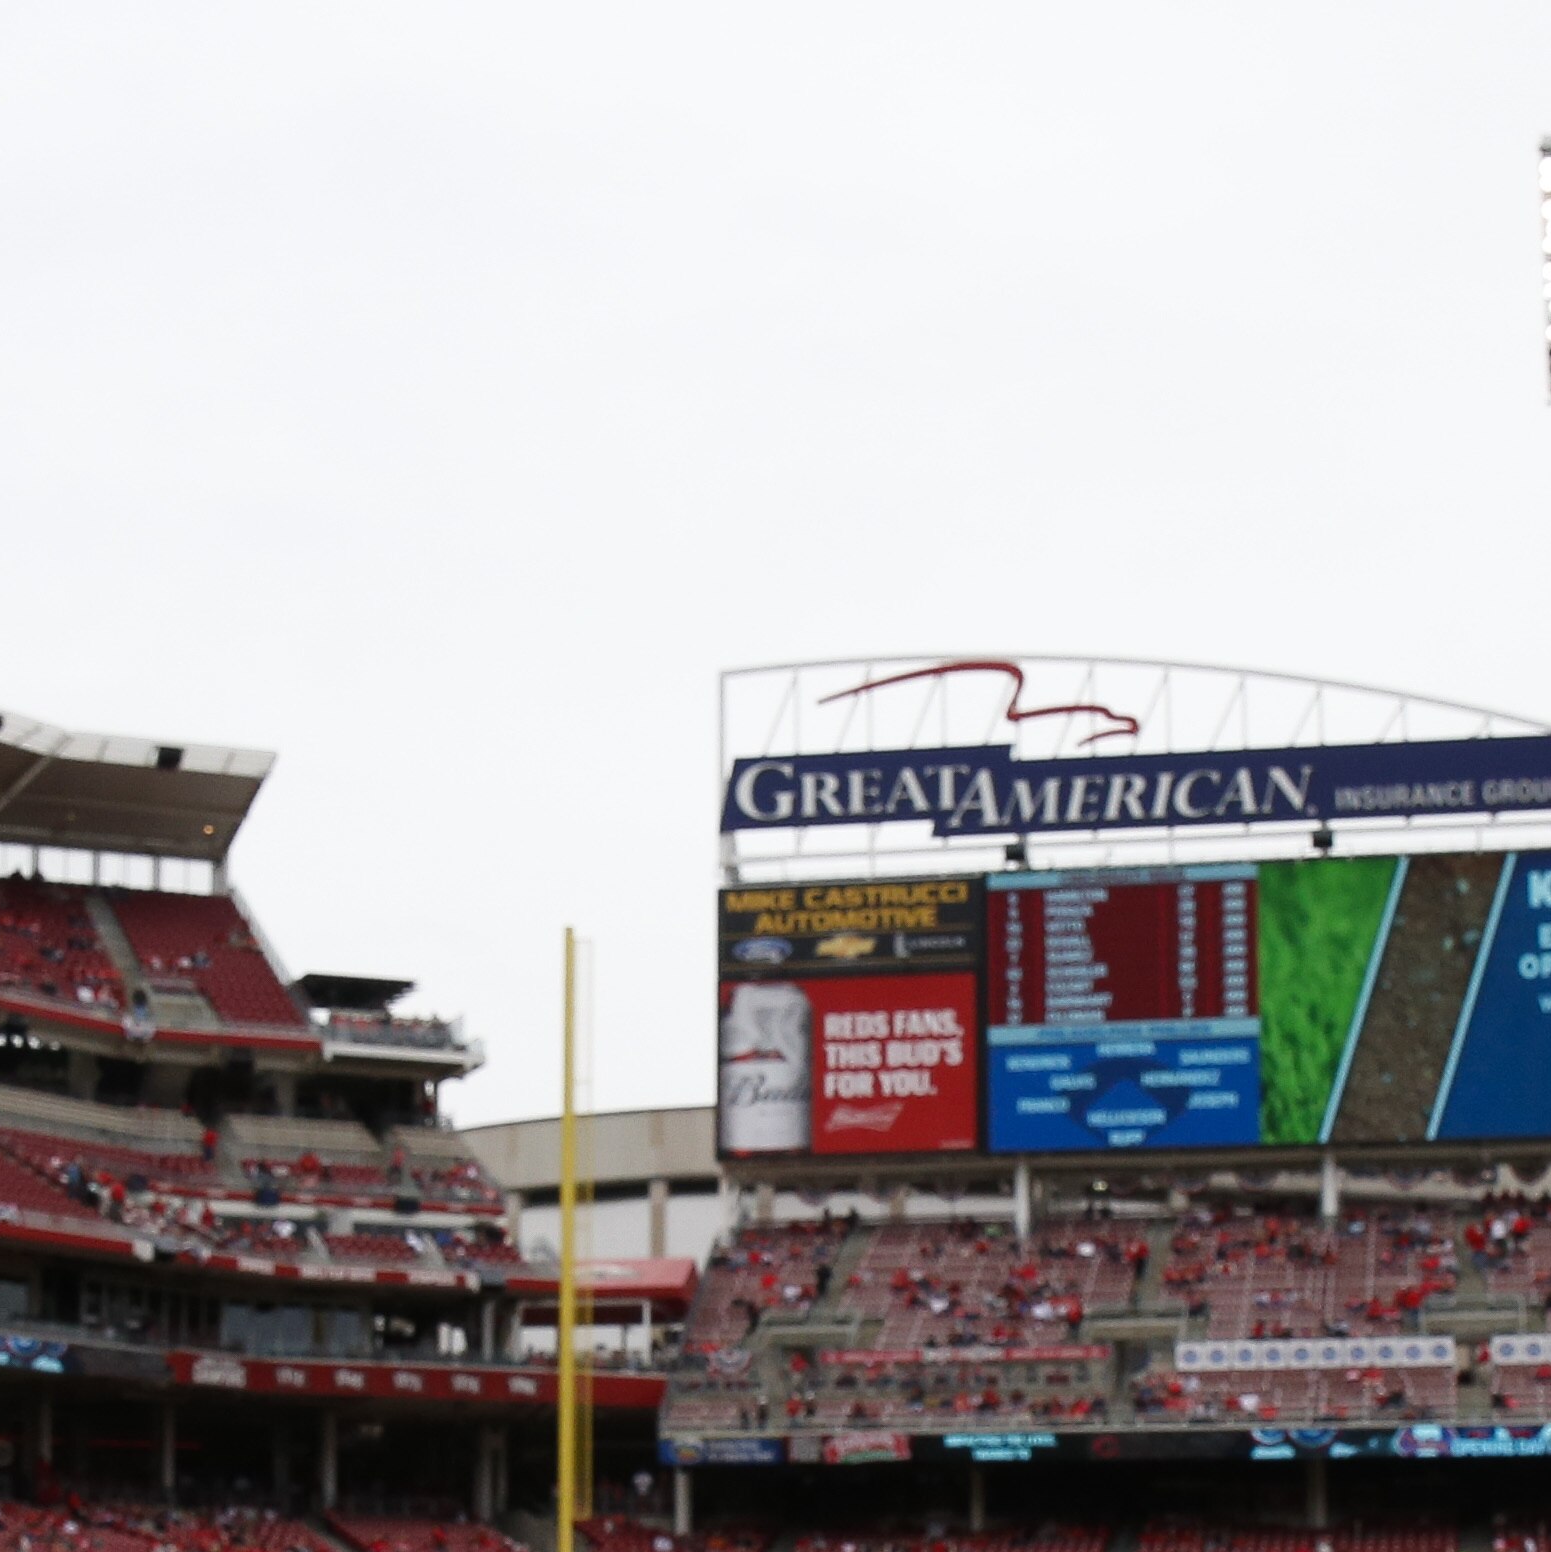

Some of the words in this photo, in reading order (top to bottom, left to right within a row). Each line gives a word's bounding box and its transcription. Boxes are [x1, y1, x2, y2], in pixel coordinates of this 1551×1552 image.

[735, 761, 970, 821] GREAT
[949, 765, 1316, 828] AMERICAN
[1335, 781, 1476, 811] INSURANCE
[753, 906, 938, 935] AUTOMOTIVE
[824, 1011, 891, 1041] REDS
[892, 1008, 965, 1038] FANS,
[824, 1041, 883, 1069] THIS
[884, 1037, 964, 1067] BUD'S
[824, 1070, 875, 1099] FOR
[877, 1068, 939, 1097] YOU.
